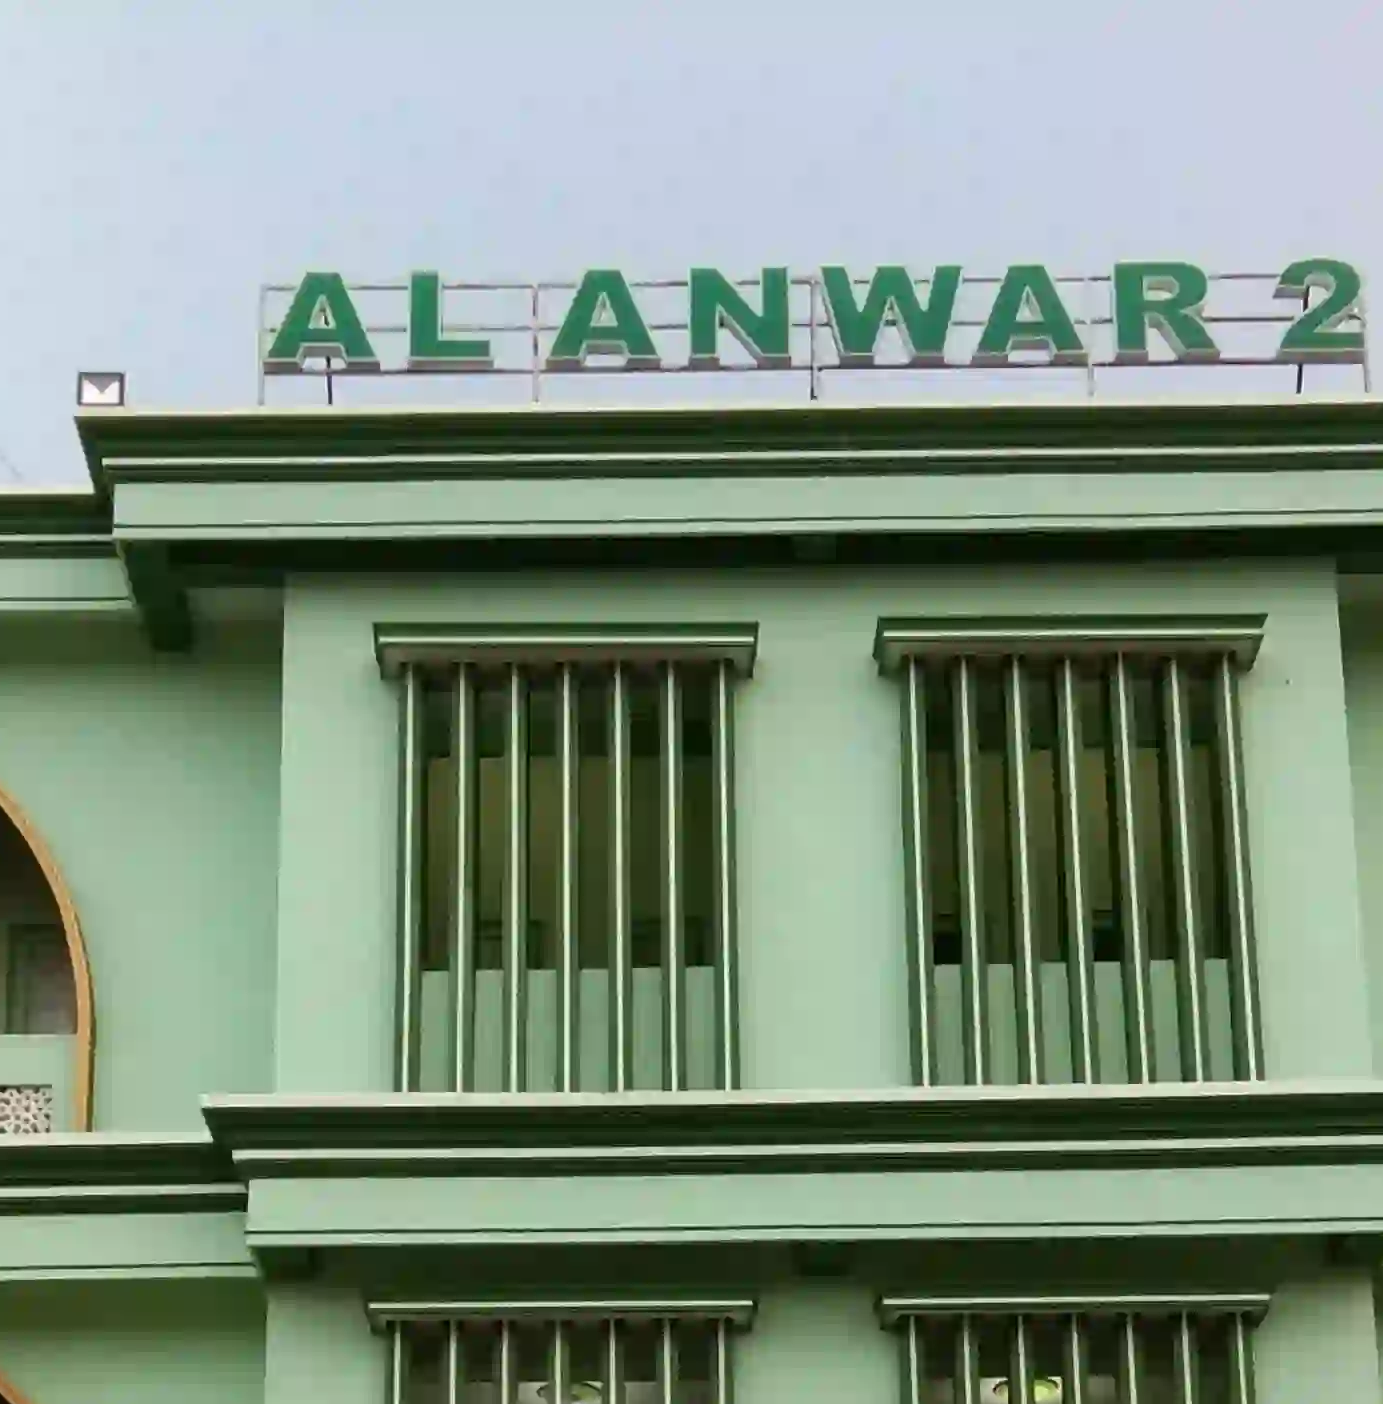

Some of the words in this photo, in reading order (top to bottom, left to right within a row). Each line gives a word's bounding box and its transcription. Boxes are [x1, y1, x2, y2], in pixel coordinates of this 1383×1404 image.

[262, 270, 494, 373] AL
[545, 263, 1222, 371] ANWAR
[1272, 257, 1367, 365] 2
